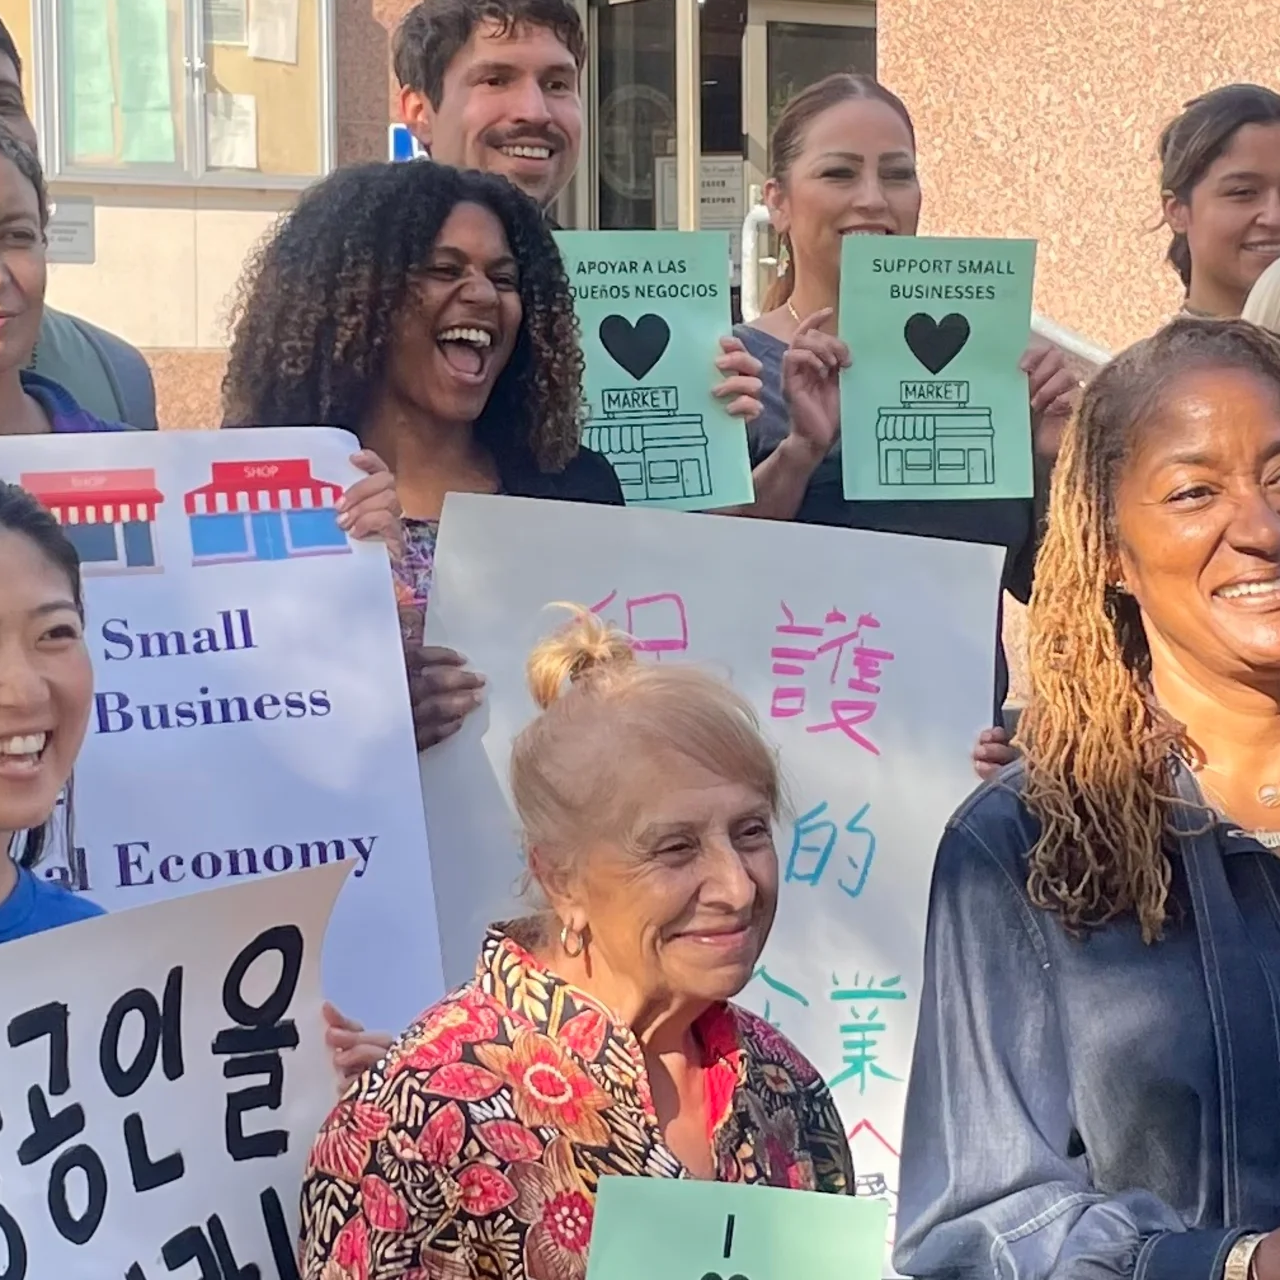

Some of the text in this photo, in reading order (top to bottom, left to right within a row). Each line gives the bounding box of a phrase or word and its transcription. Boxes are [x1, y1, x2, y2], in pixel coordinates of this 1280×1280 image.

[576, 259, 687, 275] APOYAR A LAS
[872, 258, 1016, 275] SUPPORT SMALL
[634, 283, 719, 299] NEGOCIOS
[889, 284, 996, 300] BUSINESSES
[607, 389, 673, 410] MARKET
[904, 382, 965, 400] MARKET
[242, 463, 279, 480] SHOP
[101, 607, 259, 663] Small
[93, 685, 333, 737] Business
[114, 832, 380, 890] Economy
[722, 1213, 735, 1259] I
